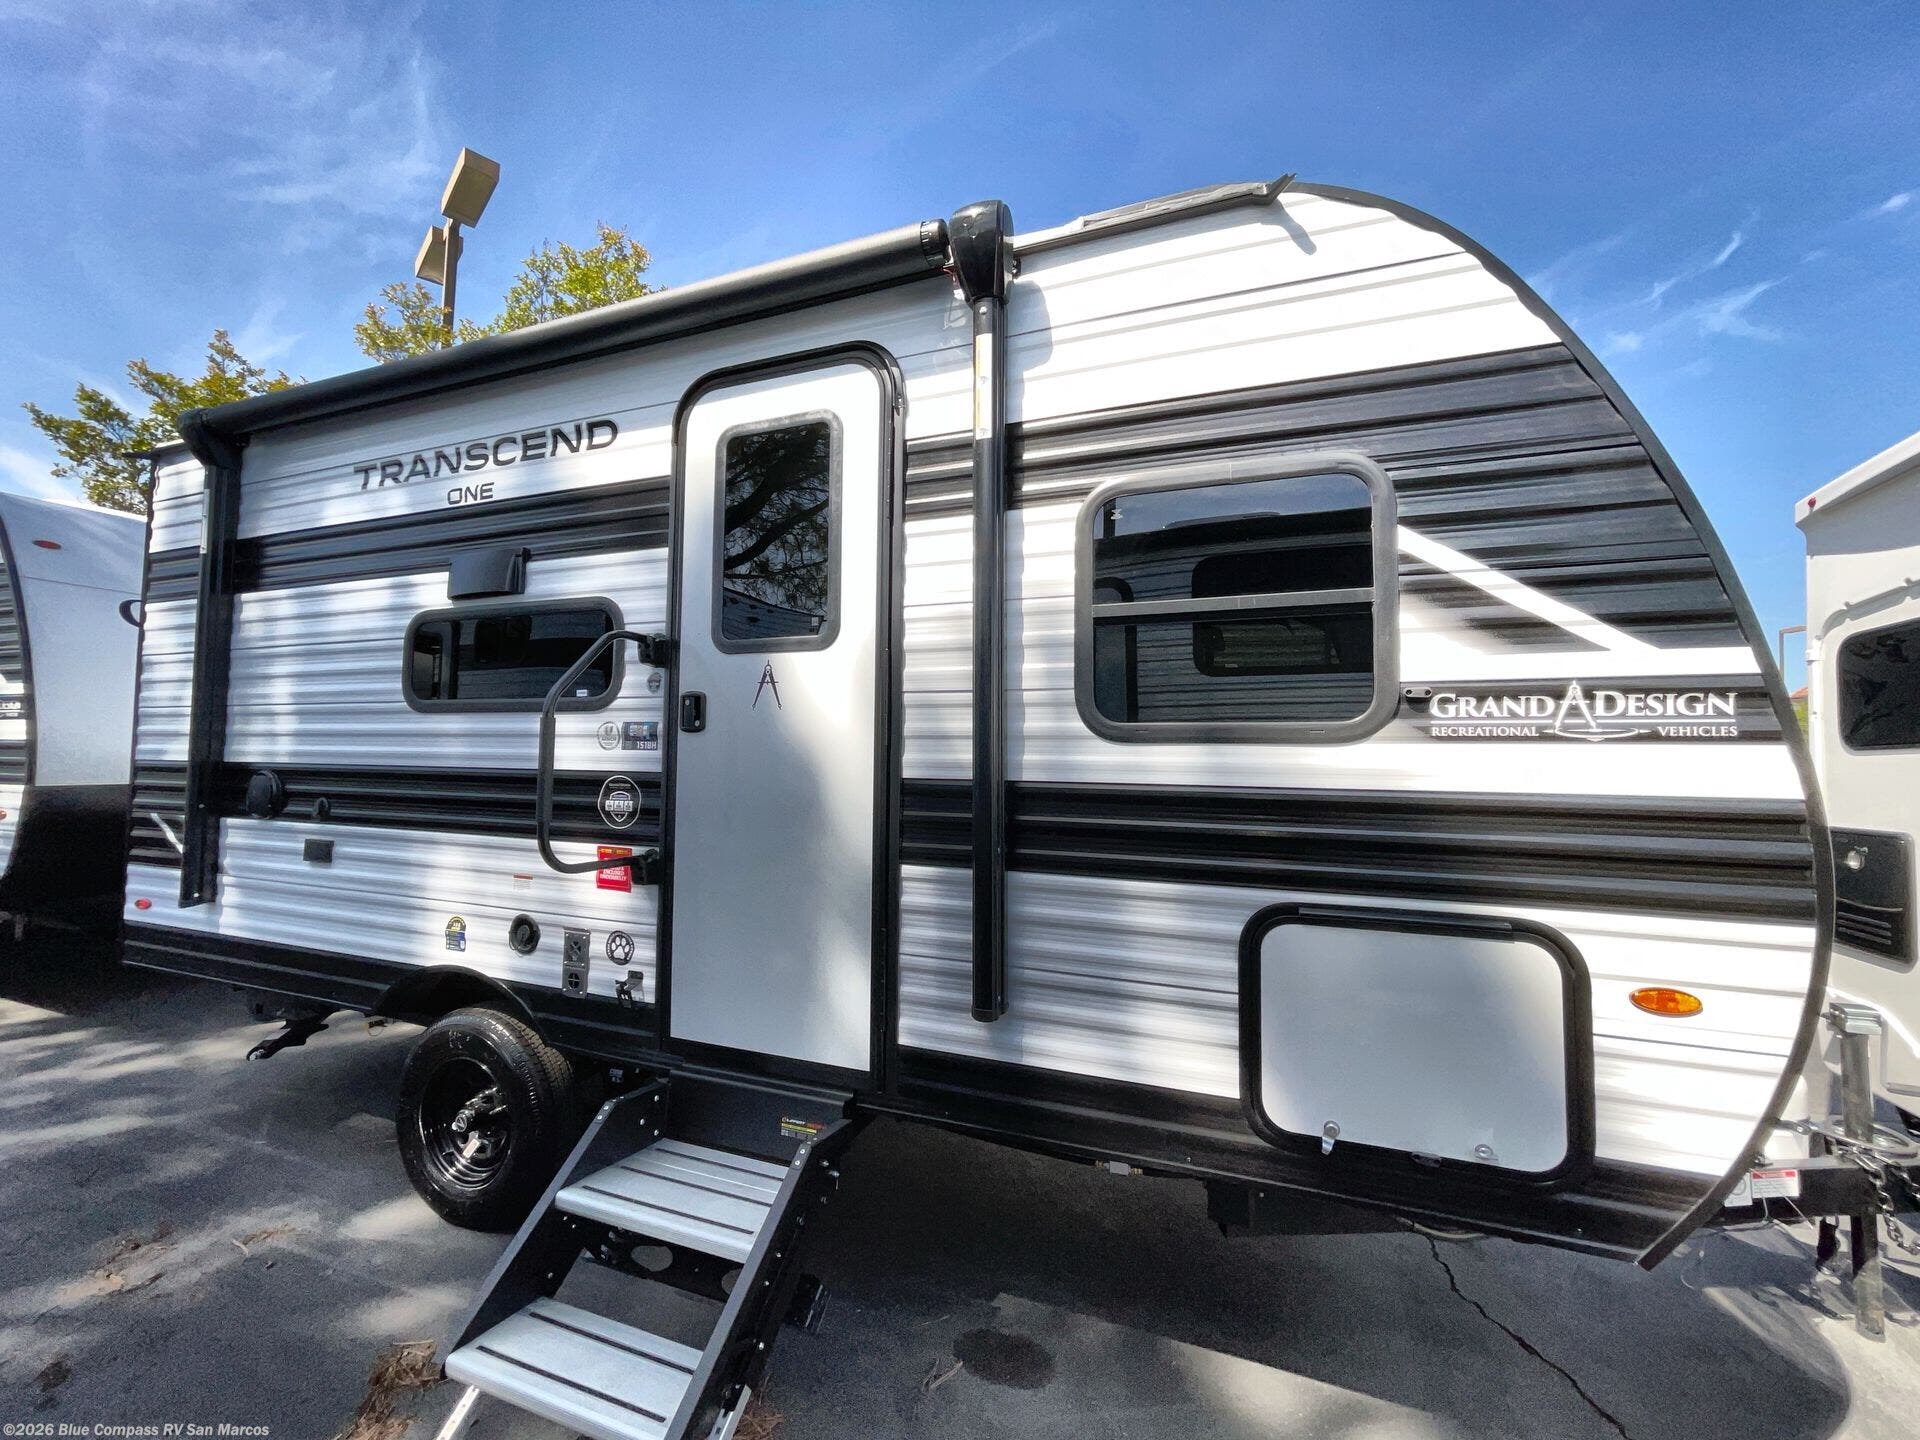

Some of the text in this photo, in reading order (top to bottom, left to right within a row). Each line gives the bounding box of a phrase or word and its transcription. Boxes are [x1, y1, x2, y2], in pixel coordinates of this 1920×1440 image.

[353, 419, 619, 490] TRANSCEND
[446, 482, 495, 505] ONE
[1429, 690, 1738, 718] GRAND DESIGN
[1431, 726, 1738, 737] RECREATIONAL VEHICLES
